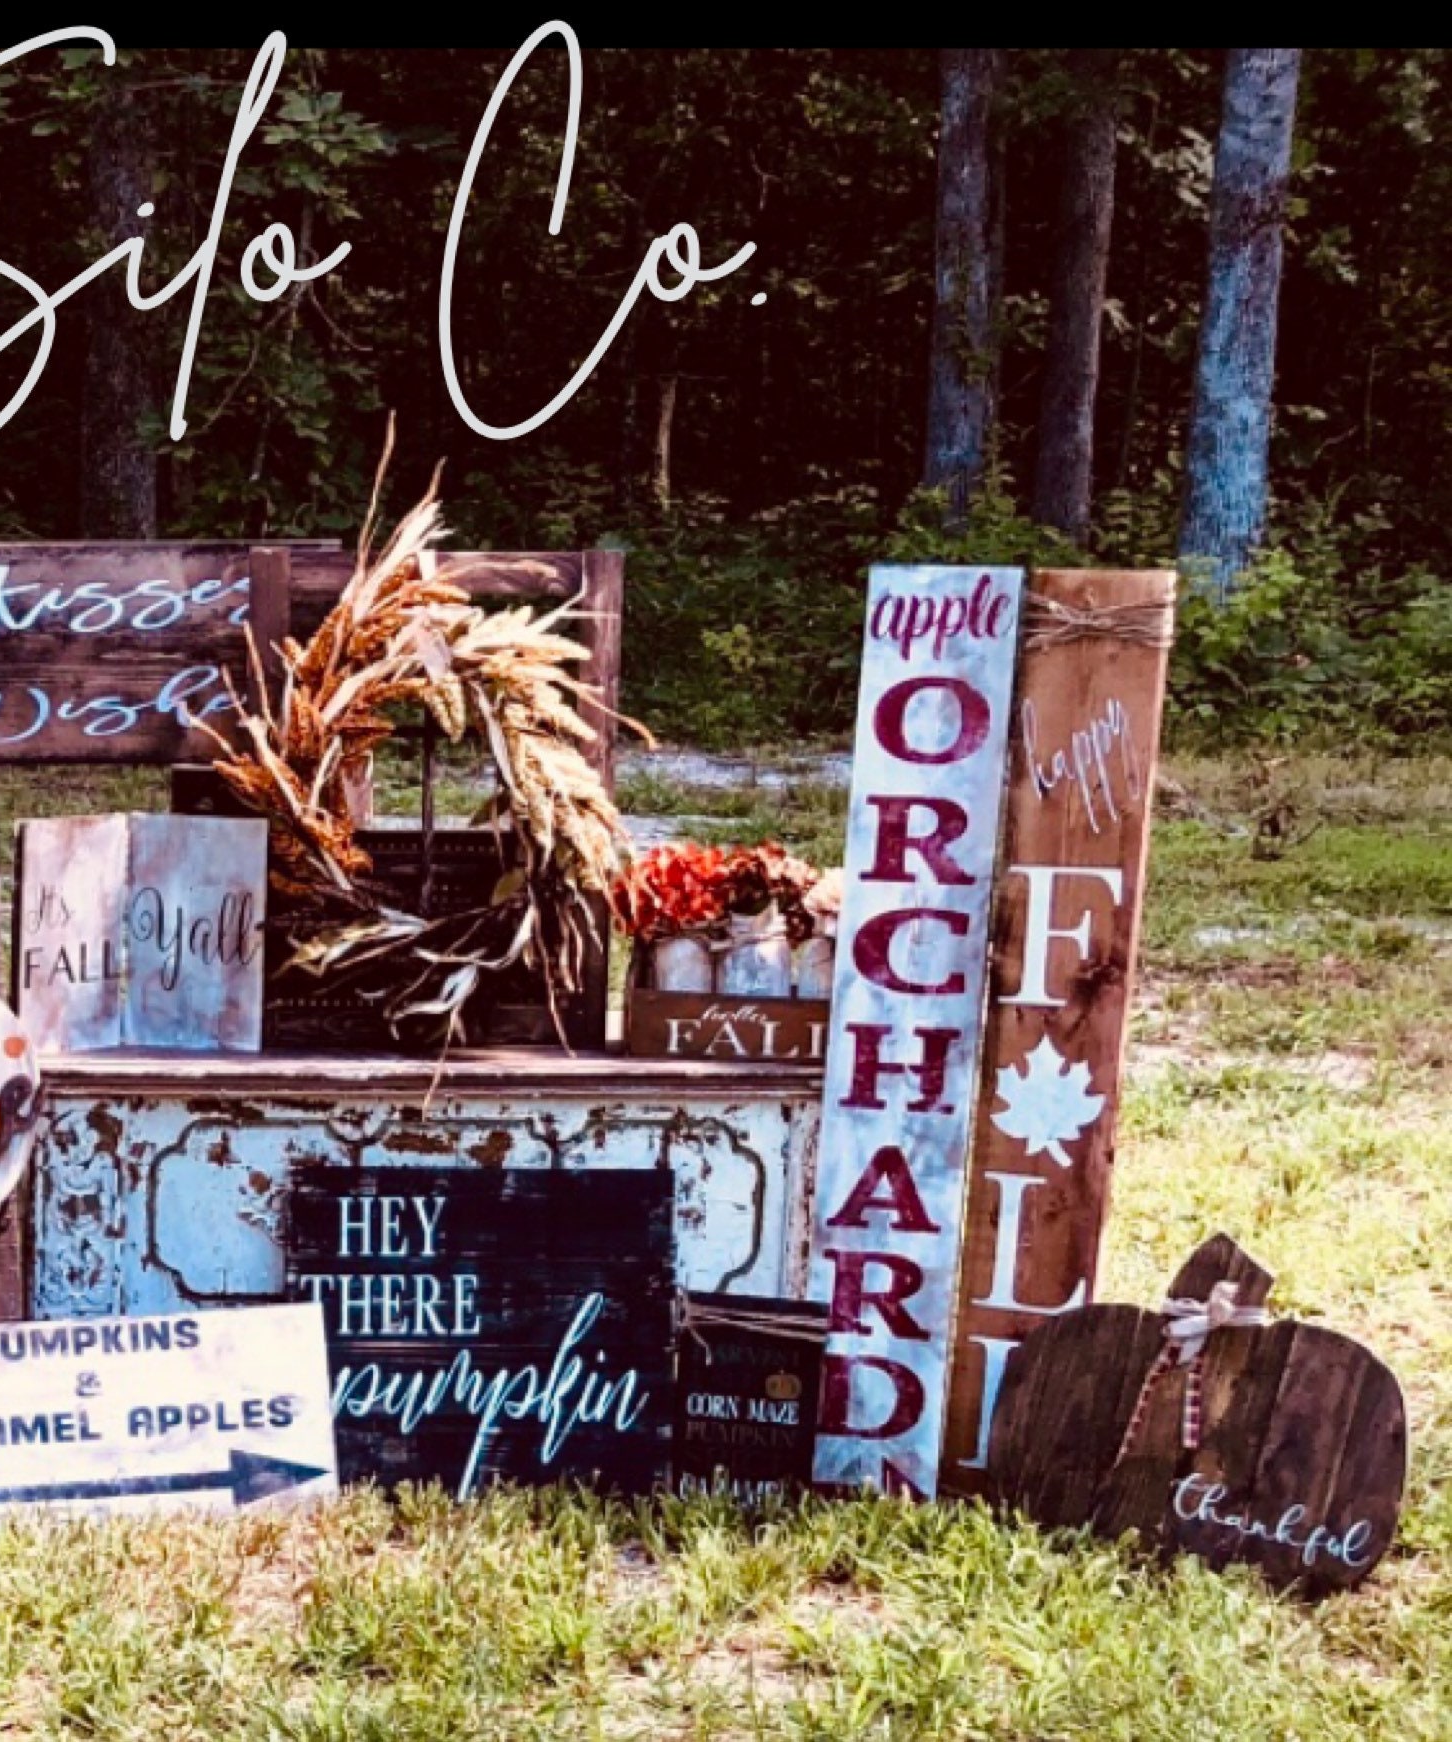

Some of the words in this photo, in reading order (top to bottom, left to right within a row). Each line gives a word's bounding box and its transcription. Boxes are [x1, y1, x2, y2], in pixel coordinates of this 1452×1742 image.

[870, 574, 1014, 663] apple
[1022, 698, 1142, 834] happy
[24, 938, 129, 990] FALL
[814, 675, 992, 1441] ORCHARD
[958, 864, 1123, 1470] FL
[336, 1196, 446, 1258] HEY
[300, 1273, 482, 1336] THERE
[75, 1371, 102, 1398] &
[126, 1397, 296, 1439] APPLES
[332, 1292, 649, 1502] pumpkin
[686, 1393, 741, 1420] CORN
[746, 1397, 800, 1425] MAZE
[1172, 1473, 1373, 1568] thankful
